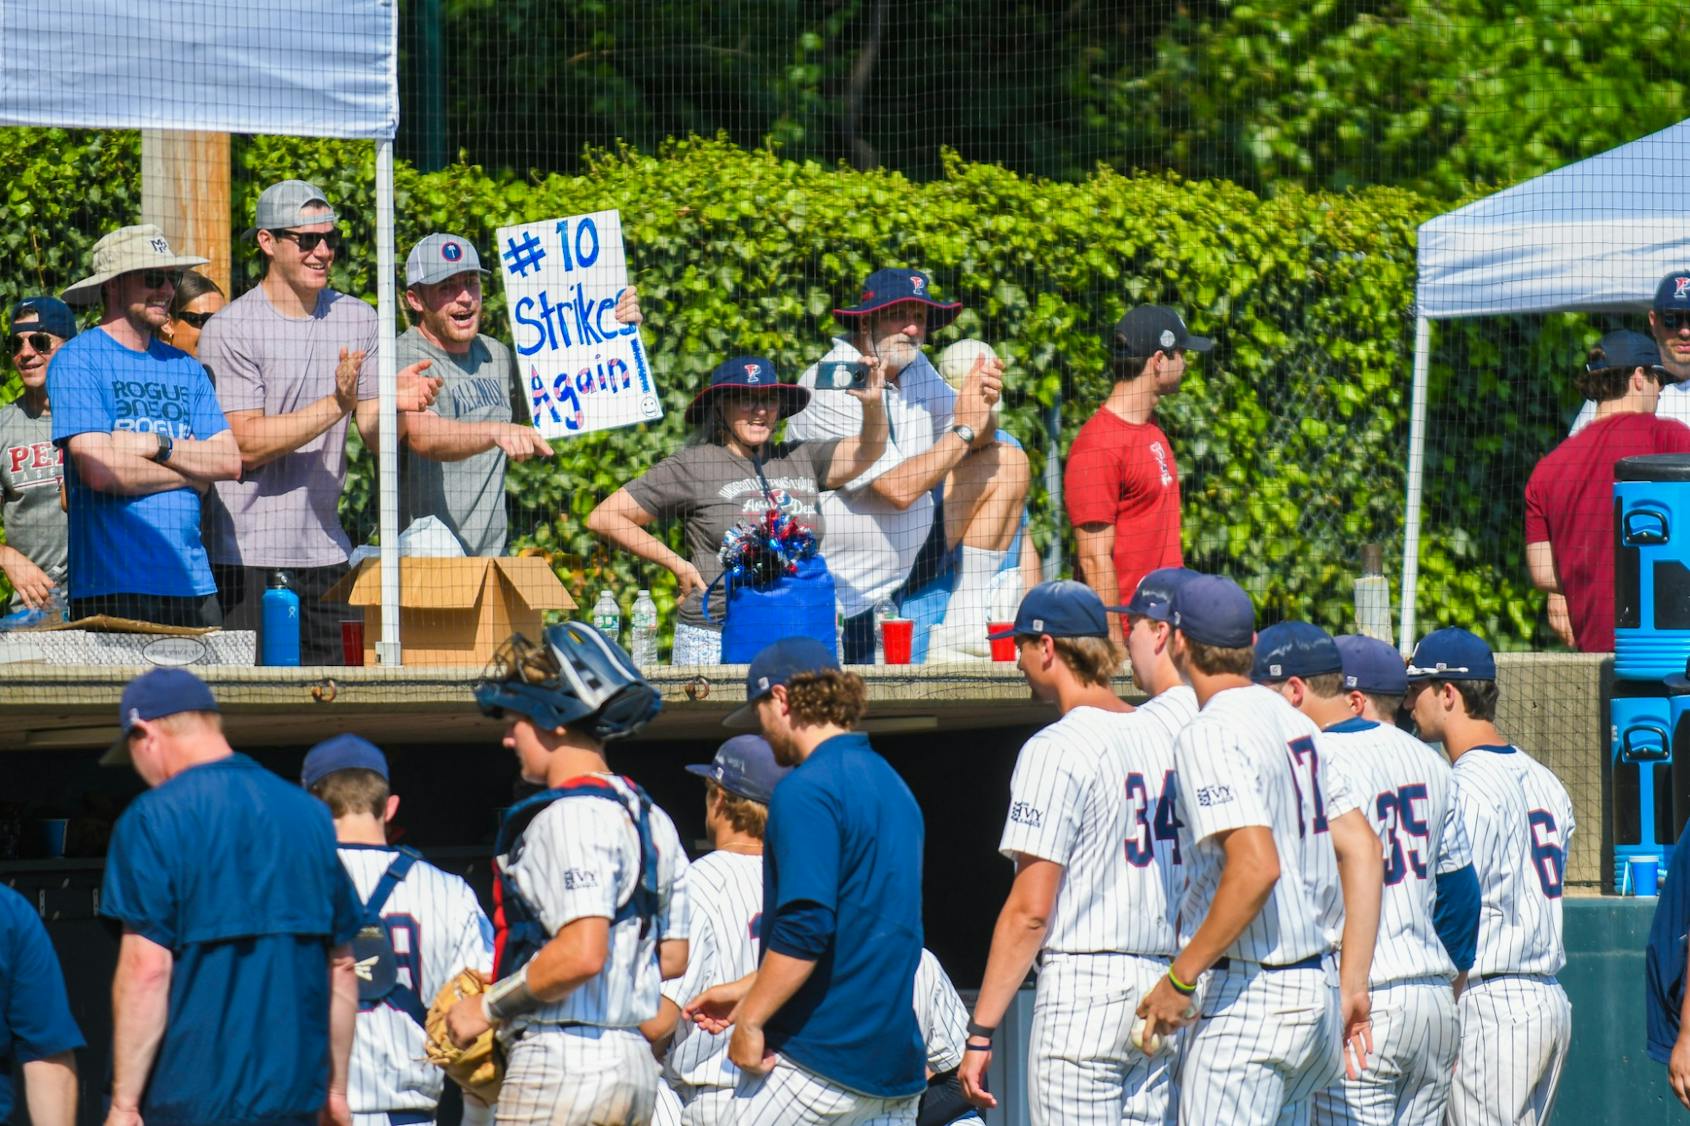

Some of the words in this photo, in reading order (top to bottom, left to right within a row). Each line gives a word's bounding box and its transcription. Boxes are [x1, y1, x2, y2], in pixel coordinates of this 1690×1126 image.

[503, 231, 546, 277] #
[555, 217, 599, 272] 10
[112, 380, 189, 403] ROGUE
[114, 417, 191, 440] ROGU
[1124, 769, 1184, 867] 34
[1376, 783, 1428, 887] 35
[1528, 808, 1563, 900] 6
